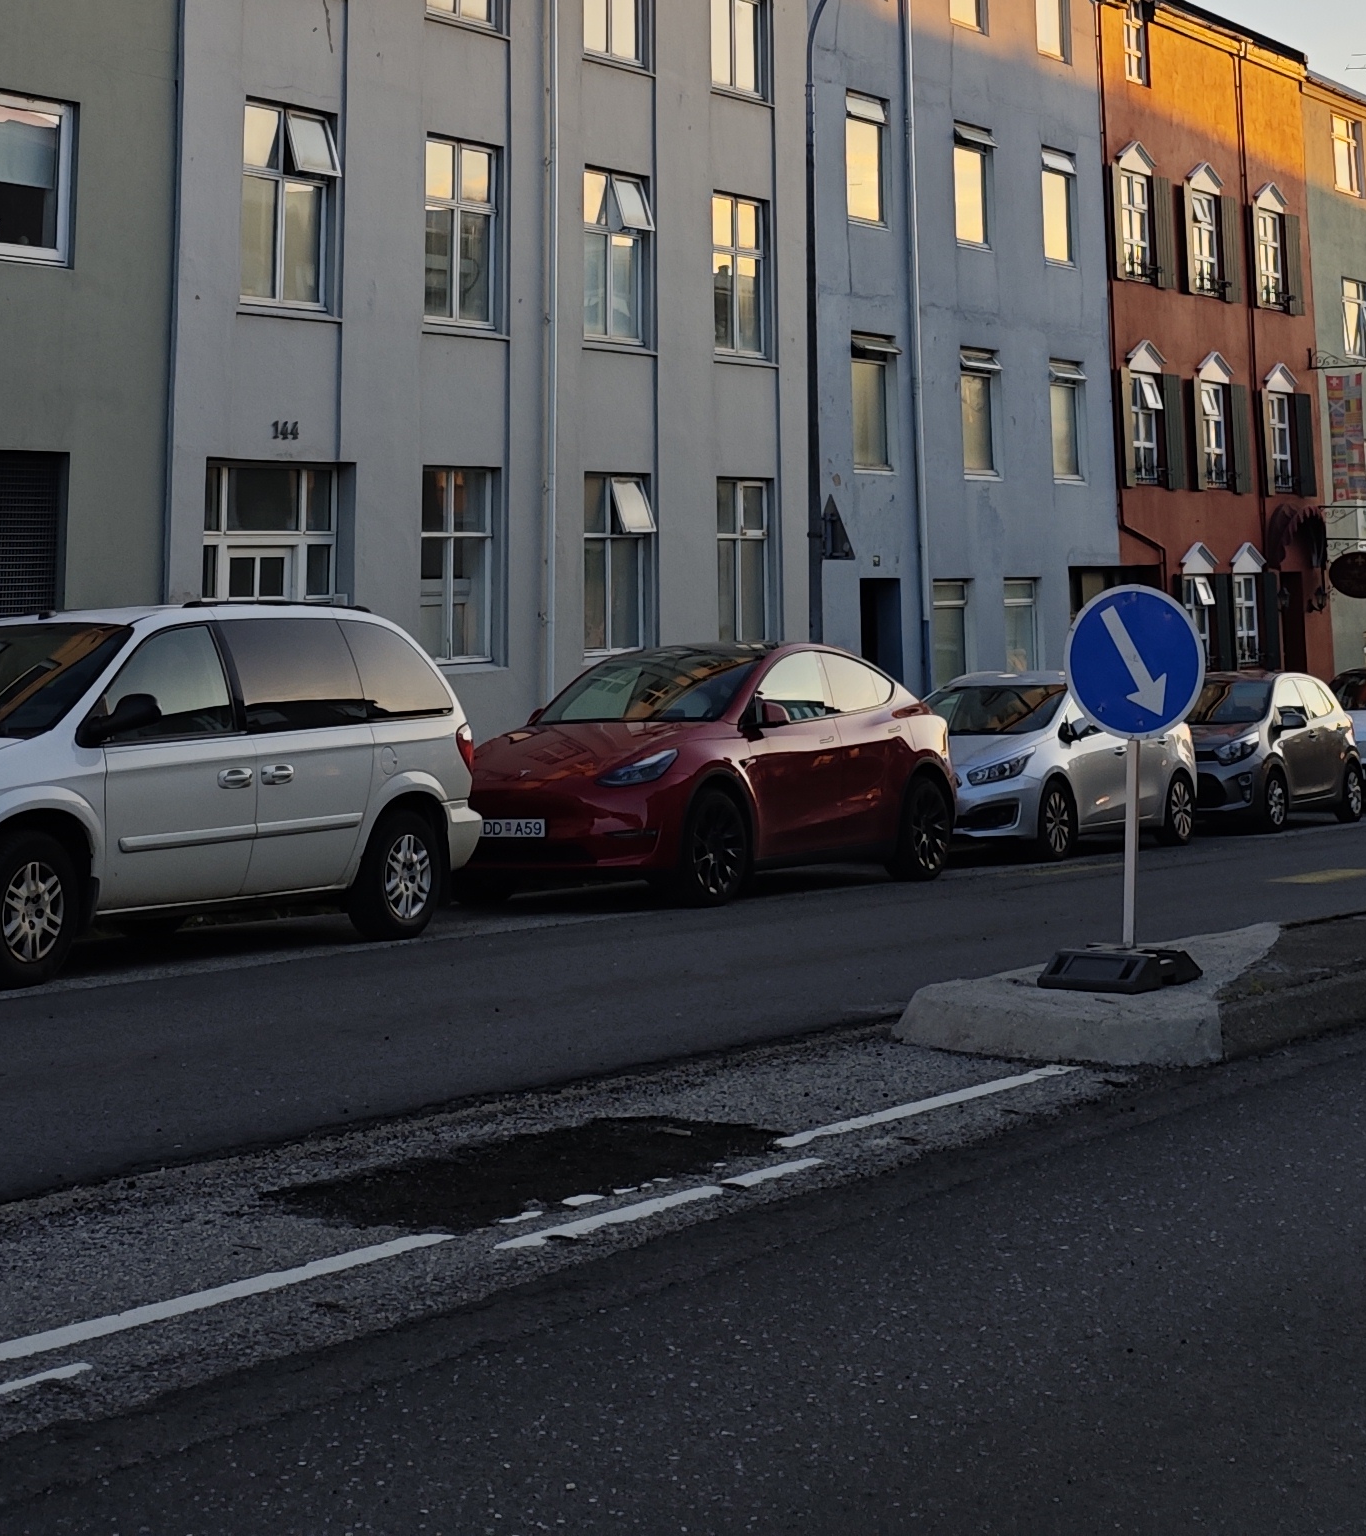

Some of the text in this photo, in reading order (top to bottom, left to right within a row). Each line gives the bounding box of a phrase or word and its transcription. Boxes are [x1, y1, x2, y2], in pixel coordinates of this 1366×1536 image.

[271, 420, 299, 440] 144
[483, 821, 542, 835] DD A59
